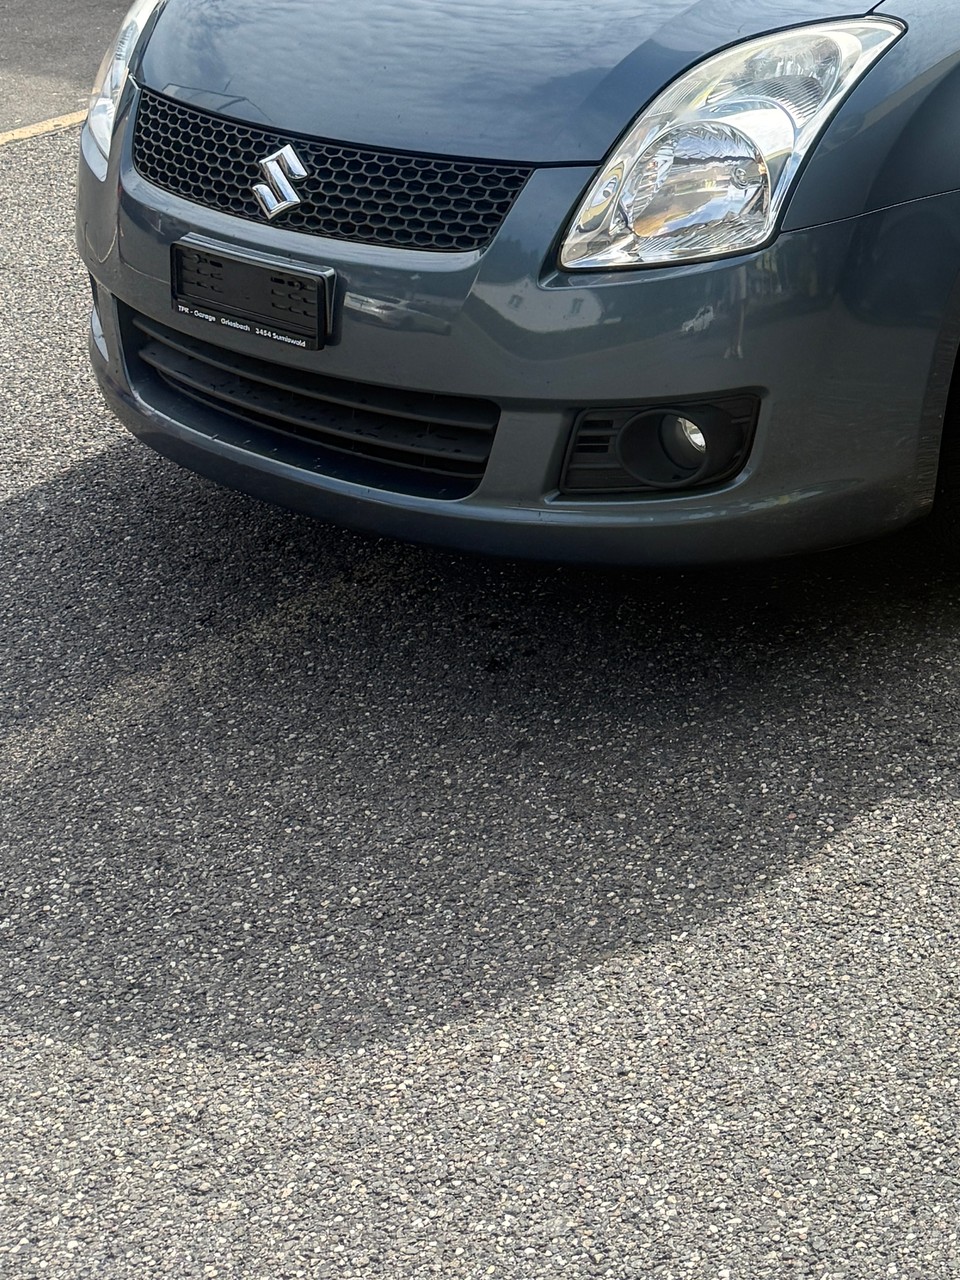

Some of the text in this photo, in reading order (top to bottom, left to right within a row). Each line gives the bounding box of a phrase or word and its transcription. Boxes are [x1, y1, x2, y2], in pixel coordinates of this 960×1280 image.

[178, 305, 189, 314] TPR
[193, 310, 216, 322] Garage
[255, 328, 271, 338] 3454
[272, 332, 306, 348] Sumiswald
